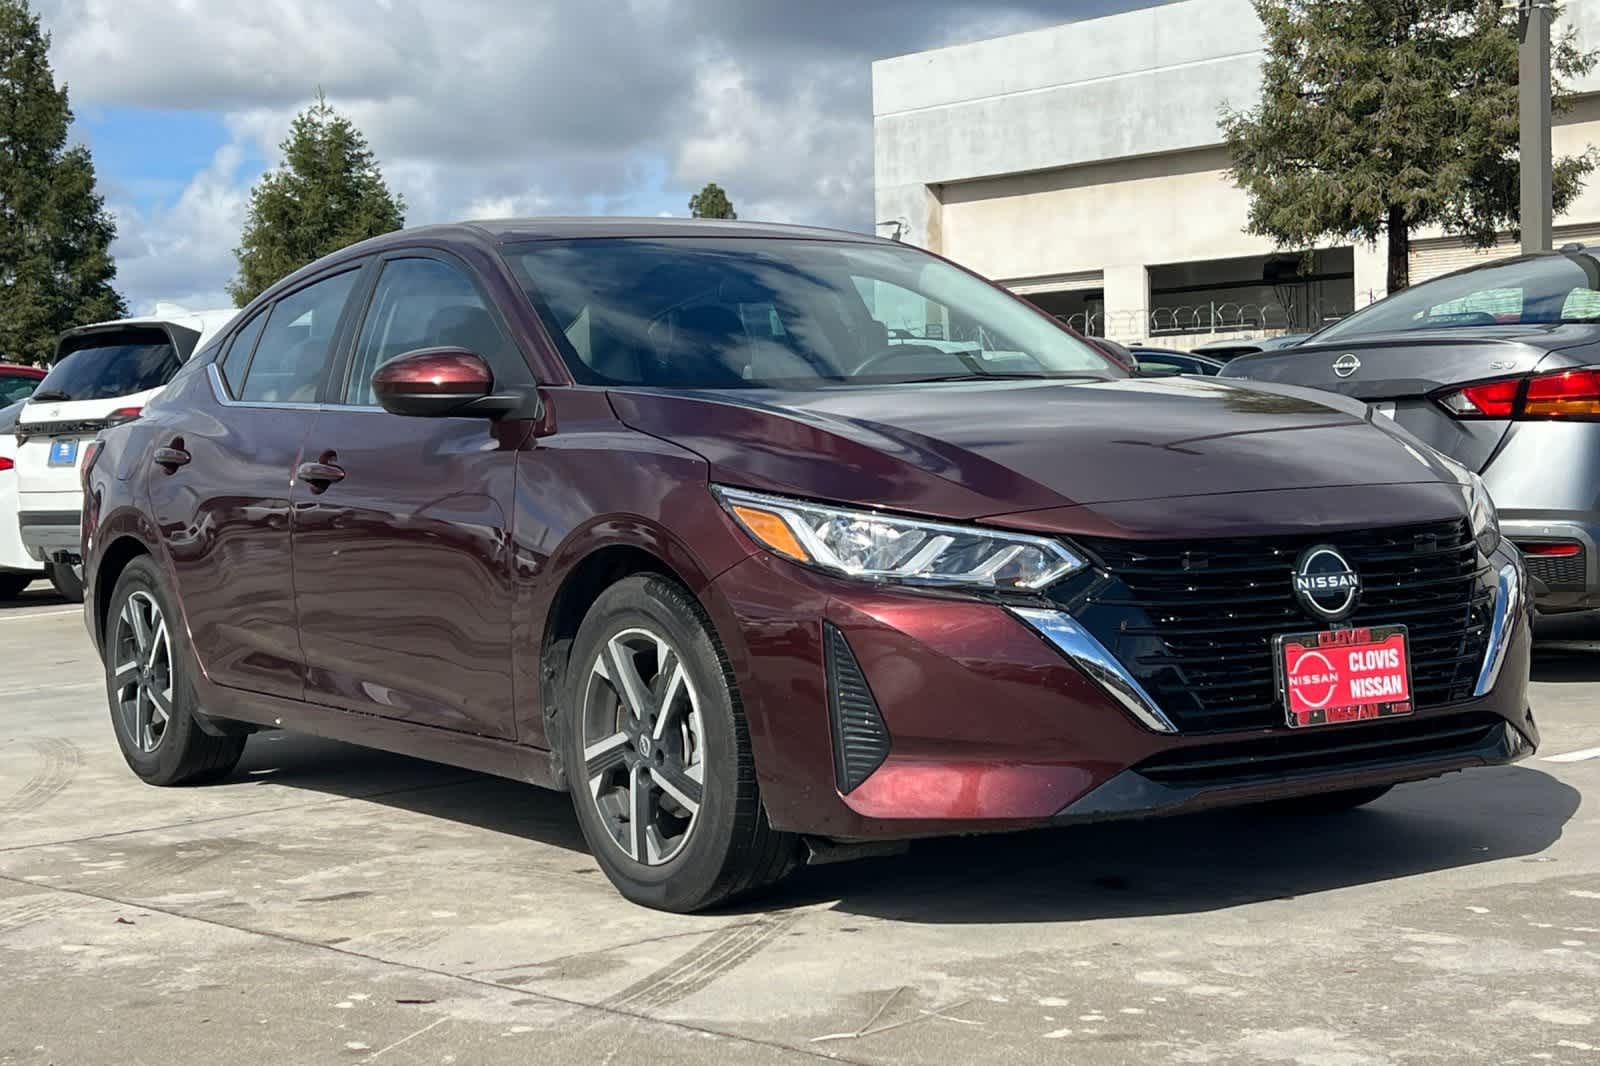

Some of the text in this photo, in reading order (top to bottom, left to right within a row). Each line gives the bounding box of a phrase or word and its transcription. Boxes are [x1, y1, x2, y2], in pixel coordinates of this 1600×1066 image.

[1490, 360, 1519, 370] SV
[1297, 574, 1358, 589] NISSAN
[1349, 648, 1399, 672] CLOVIS
[1289, 672, 1339, 686] NISSAN
[1350, 675, 1402, 699] NISSAN
